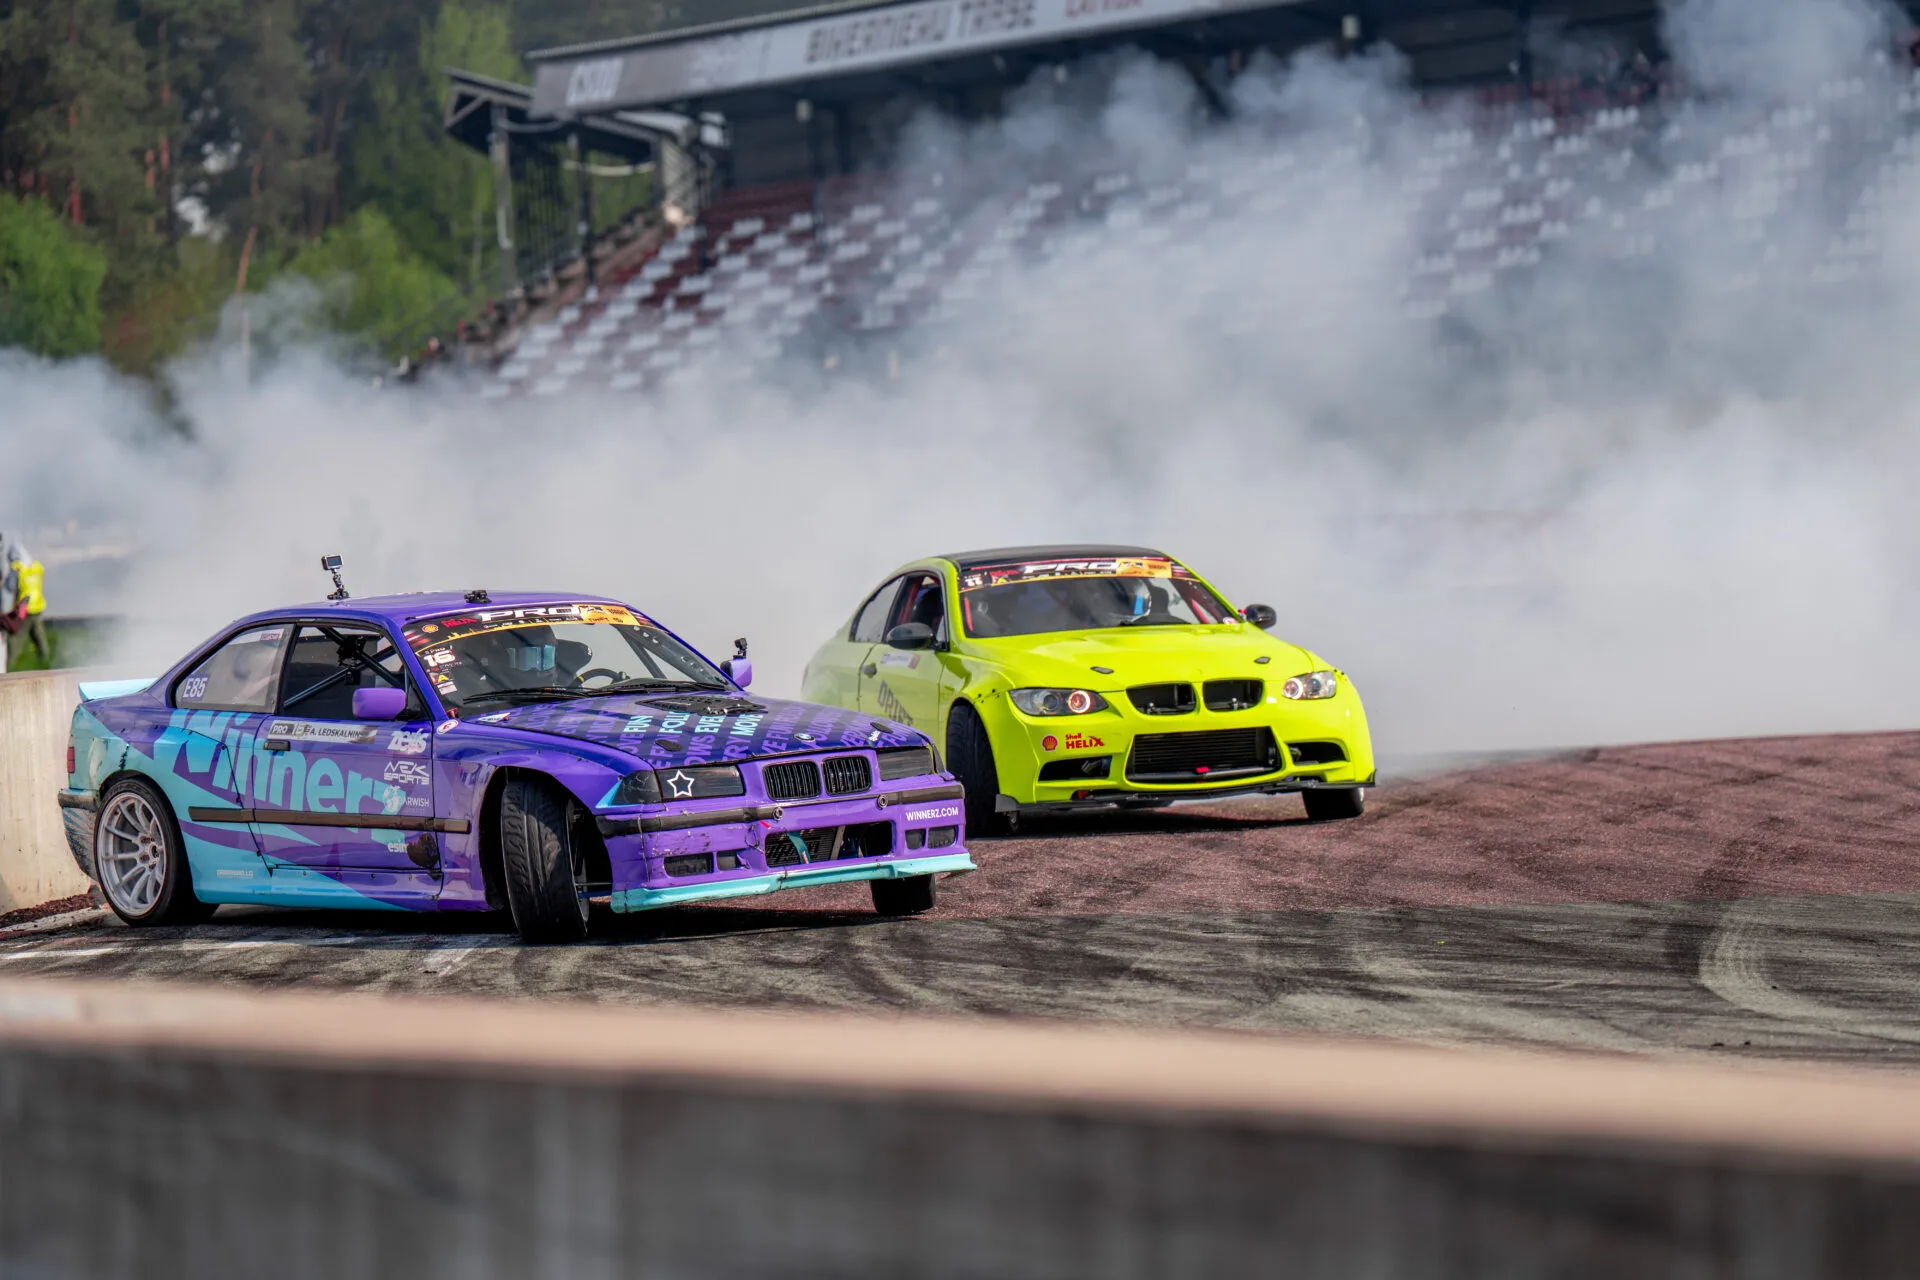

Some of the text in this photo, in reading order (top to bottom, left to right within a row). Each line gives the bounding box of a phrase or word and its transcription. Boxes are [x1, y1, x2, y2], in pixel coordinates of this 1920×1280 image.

[478, 606, 580, 622] PRO
[423, 650, 455, 667] 16
[182, 677, 208, 698] E85
[272, 725, 288, 735] PRO
[623, 715, 654, 733] FUN
[1065, 736, 1105, 749] HELIX
[384, 772, 430, 785] SPORTS
[906, 806, 959, 821] WINNERZ.COM
